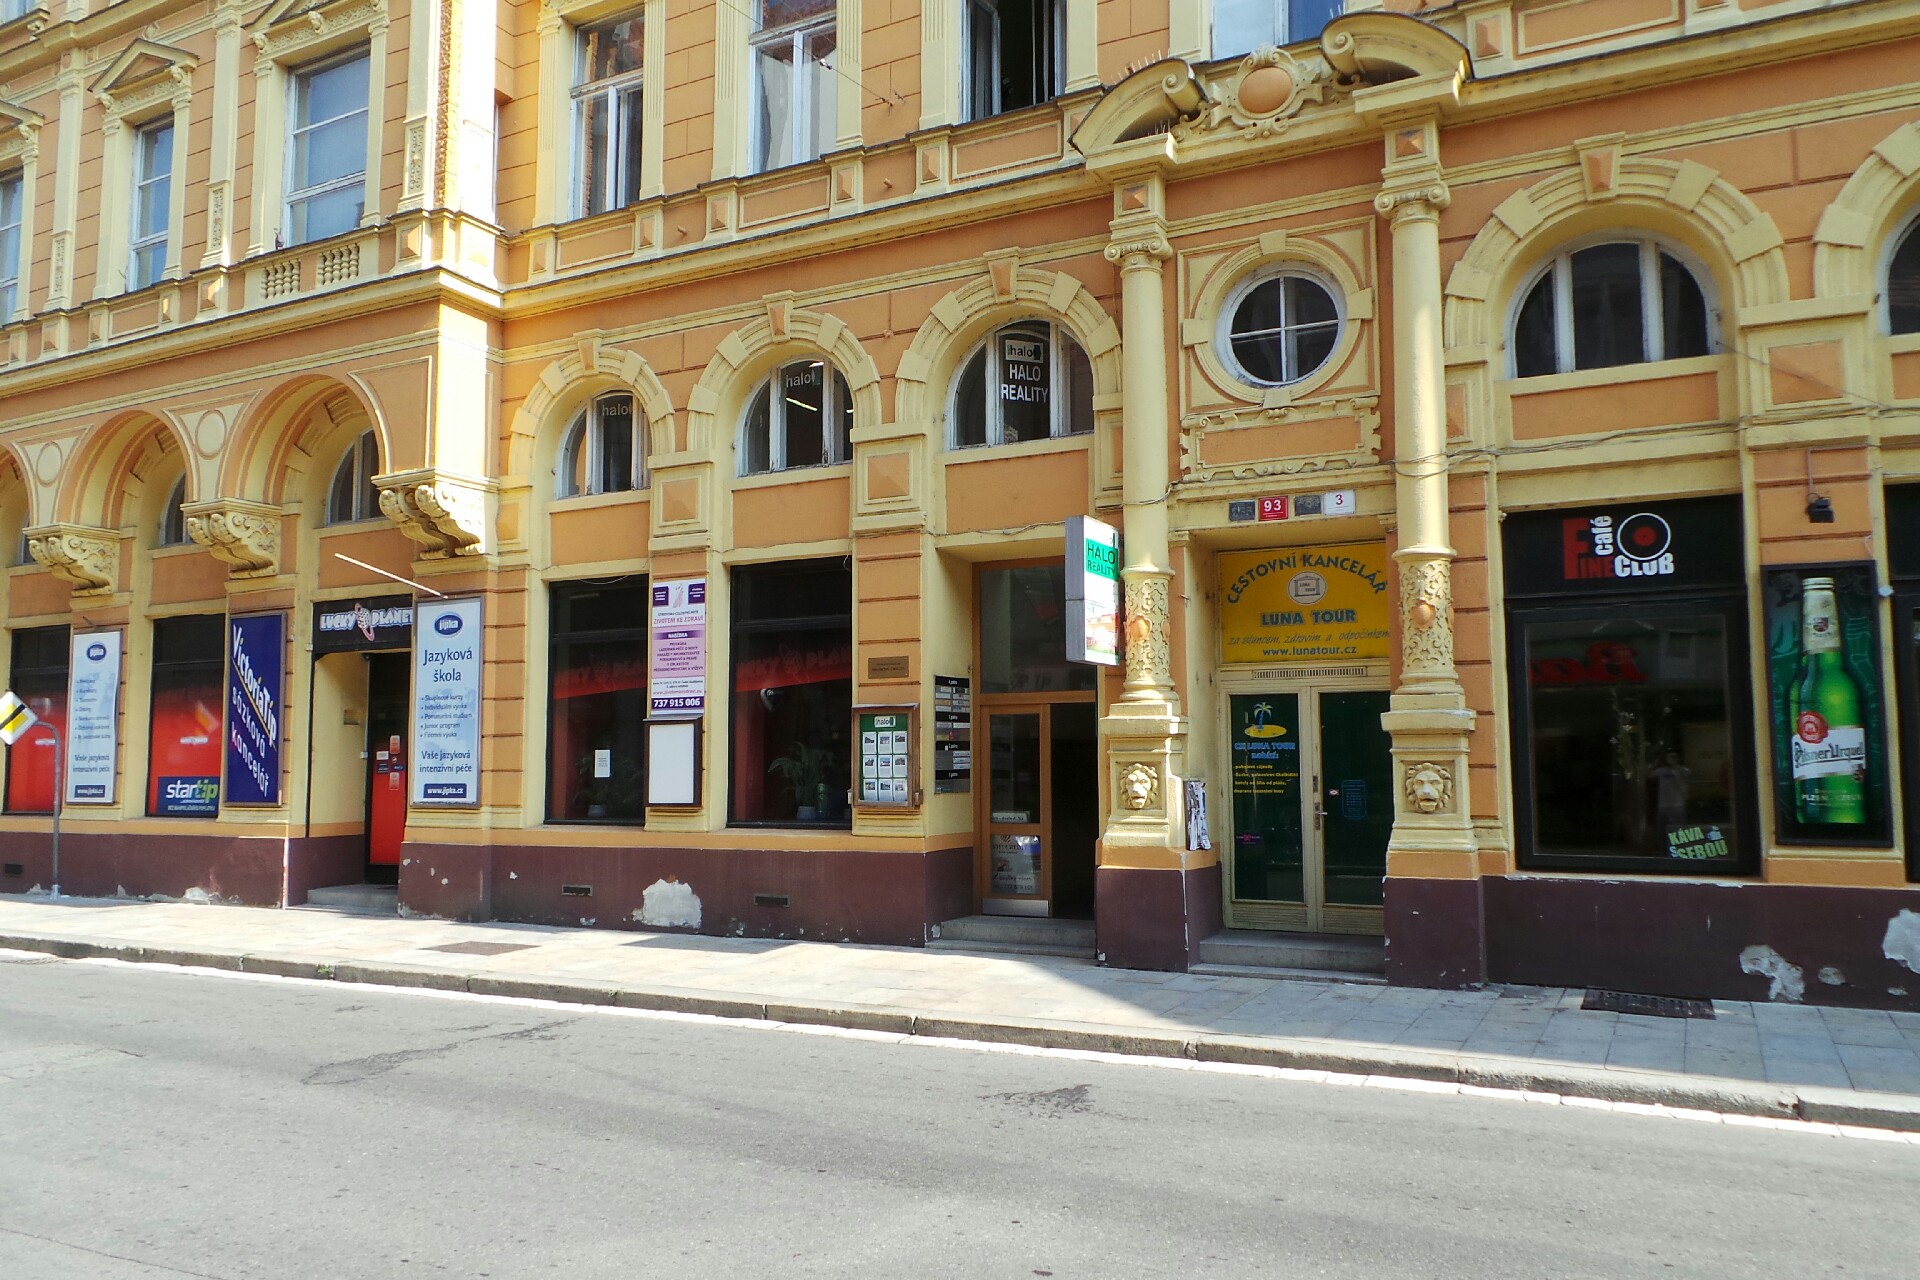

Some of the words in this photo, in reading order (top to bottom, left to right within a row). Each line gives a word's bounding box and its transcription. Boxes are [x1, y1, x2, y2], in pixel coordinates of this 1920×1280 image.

[1009, 363, 1041, 382] HALO
[1001, 384, 1048, 403] REALITY
[1263, 499, 1282, 512] 93
[1335, 494, 1344, 505] 3
[1590, 515, 1613, 556] café
[1087, 542, 1116, 565] HALO
[1087, 560, 1116, 578] REALITY
[1614, 552, 1675, 577] CLUB
[1227, 552, 1297, 604] CESTOVNÍ
[1302, 553, 1388, 594] KANCELÁŘ
[320, 611, 356, 632] LUCKY
[1261, 612, 1304, 627] LUNA
[1312, 609, 1357, 625] TOUR
[423, 646, 473, 667] Jazyková
[1262, 645, 1357, 656] www.lunatour.cz
[433, 667, 462, 682] škola
[232, 624, 277, 748] VictoriaTip
[653, 699, 669, 708] 737
[669, 698, 684, 707] 915
[685, 697, 701, 707] 006
[232, 685, 266, 759] sázková
[231, 721, 270, 798] kancelář
[421, 750, 439, 759] Vaše
[439, 749, 471, 761] jazyková
[455, 763, 473, 774] péče
[165, 779, 219, 803] startip
[1668, 827, 1705, 846] KÁVA
[1677, 839, 1729, 859] SEBOU
